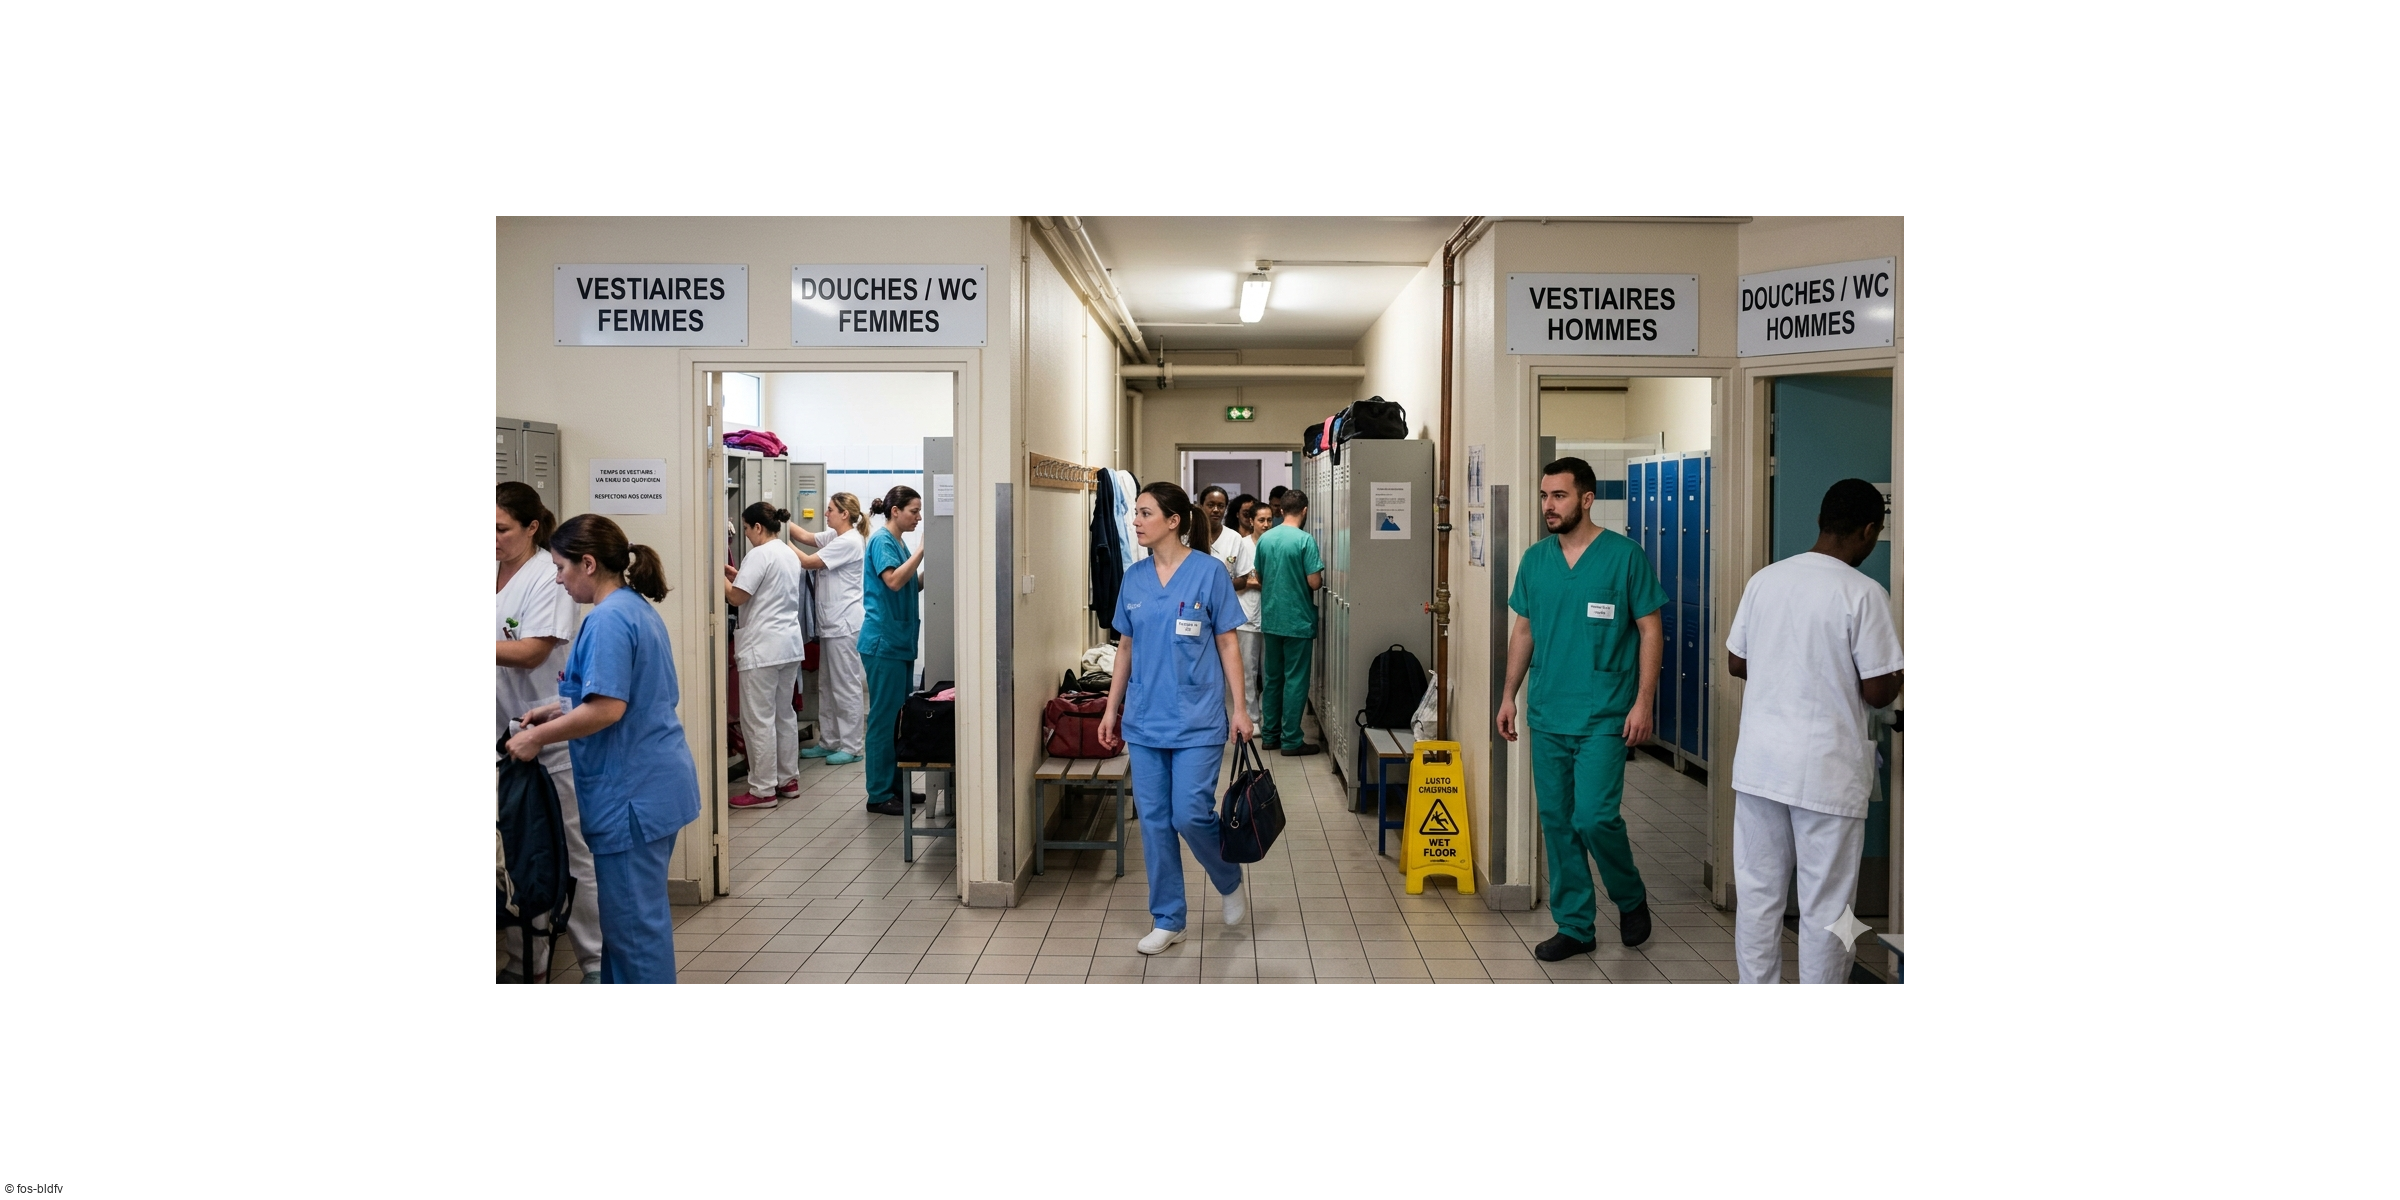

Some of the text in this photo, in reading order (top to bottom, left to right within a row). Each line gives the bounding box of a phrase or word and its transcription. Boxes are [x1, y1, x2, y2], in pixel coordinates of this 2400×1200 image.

[576, 277, 726, 301] VESTIAIRES
[801, 277, 978, 301] DOUCHES / WC
[1529, 286, 1676, 311] VESTIAIRES
[1742, 272, 1890, 312] DOUCHES / WC
[598, 308, 704, 333] FEMMES
[839, 309, 940, 333] FEMMES
[1548, 317, 1658, 342] HOMMES
[1766, 309, 1856, 341] HOMMES
[1423, 848, 1457, 857] FLOOR
[1429, 838, 1451, 847] WET
